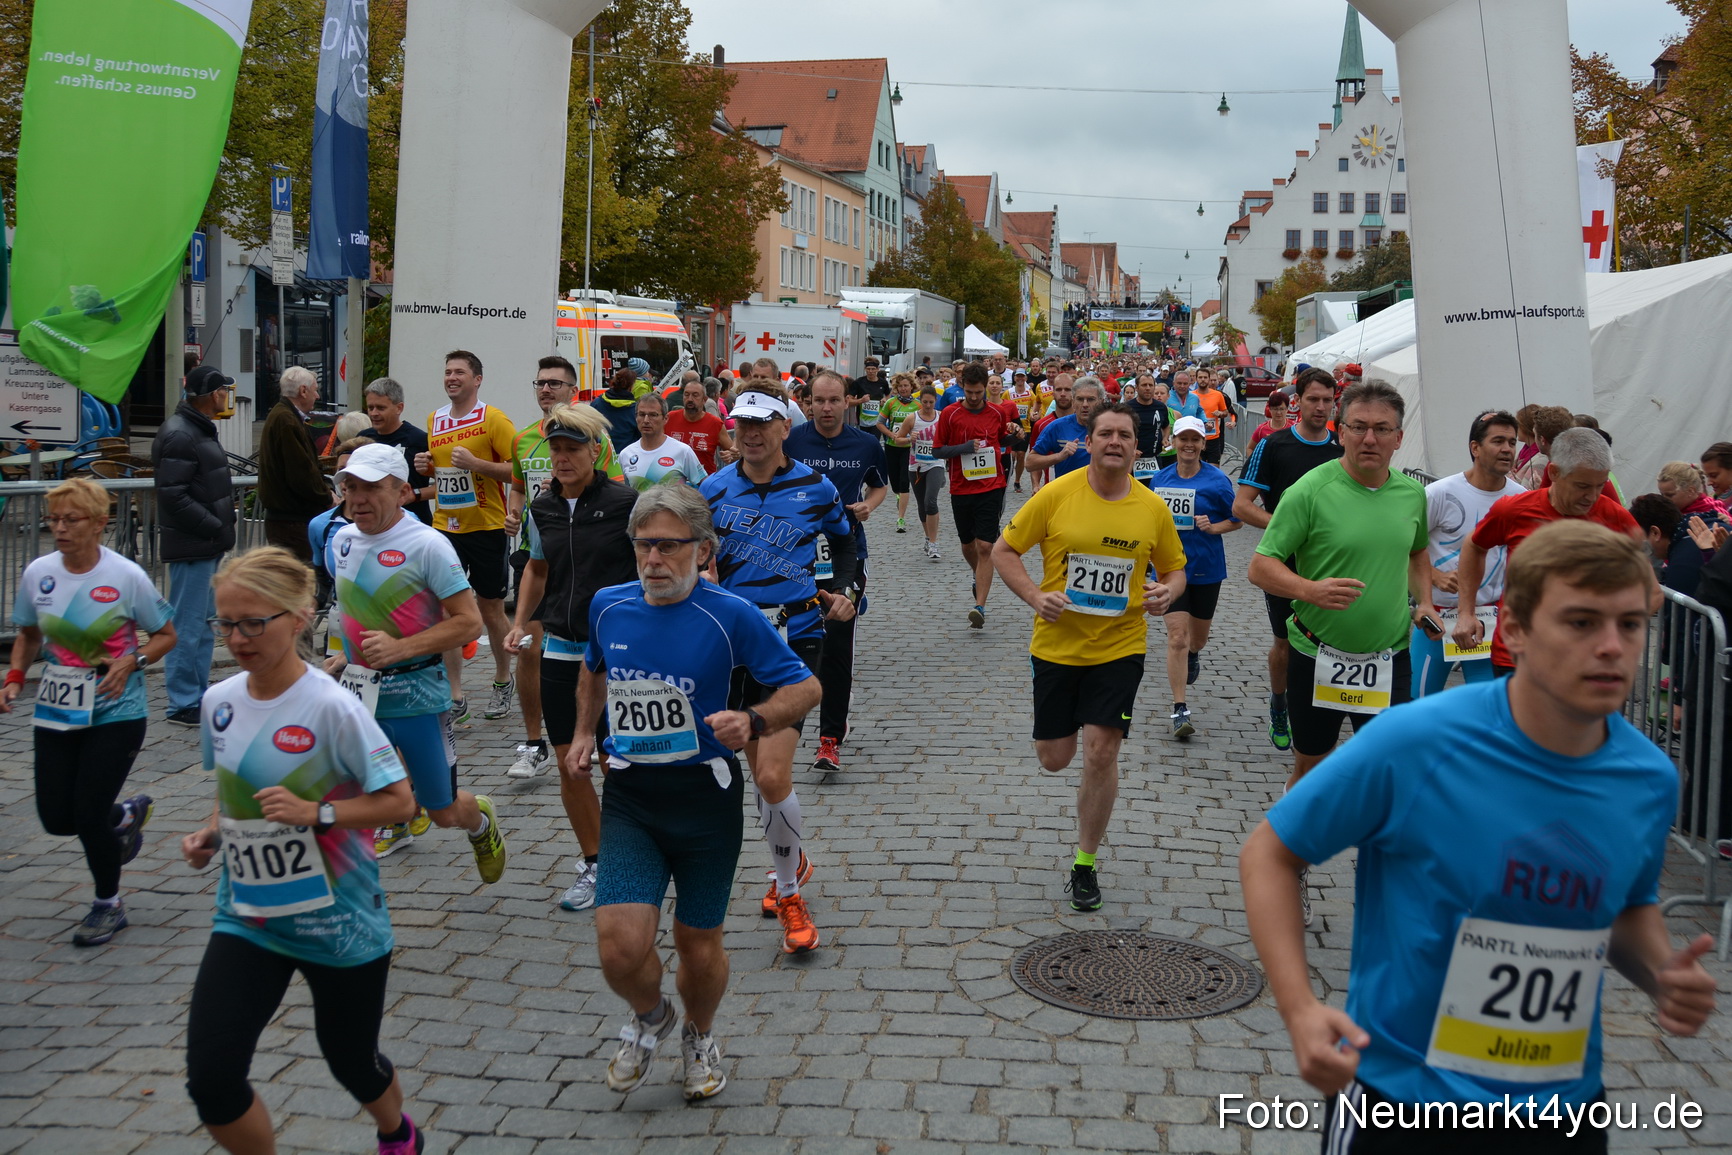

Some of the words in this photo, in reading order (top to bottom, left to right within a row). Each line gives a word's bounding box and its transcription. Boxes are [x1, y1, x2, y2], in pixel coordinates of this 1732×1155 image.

[194, 239, 203, 276] P
[226, 299, 233, 315] 3
[394, 301, 527, 319] www.bmw-laufsport.de
[1443, 304, 1585, 324] www.bmw-laufsport.de
[1112, 323, 1138, 331] START
[778, 331, 814, 341] Bayerisches
[778, 339, 796, 347] Rotes
[777, 346, 795, 354] Kreuz
[4, 379, 45, 390] Kreuzung
[46, 380, 66, 389] über
[21, 391, 50, 401] Untere
[8, 402, 63, 415] Kaserngasse
[430, 436, 454, 449] MAX
[457, 426, 487, 442] BÖGL
[803, 458, 827, 468] EURO
[835, 460, 861, 469] POLES
[971, 455, 986, 468] 15
[1135, 462, 1157, 471] 2209
[437, 476, 470, 493] 2730
[719, 503, 805, 553] TEAM
[1070, 555, 1092, 566] PARTL
[1093, 560, 1125, 570] Neumarkt
[1072, 566, 1127, 595] 2180
[1087, 596, 1106, 608] Uwe
[1319, 649, 1344, 662] PARTL
[1345, 654, 1380, 664] Neumarkt
[1330, 662, 1378, 688] 220
[39, 678, 85, 707] 2021
[630, 686, 673, 697] Neumarkt
[1339, 690, 1364, 704] Gerd
[614, 698, 686, 732] 2608
[629, 739, 672, 753] Johann
[241, 827, 292, 840] Neumarkt
[228, 839, 312, 880] 3102
[1502, 857, 1602, 913] RUN
[1460, 931, 1520, 957] PARTL
[1523, 943, 1594, 961] Neumarkt
[1480, 963, 1583, 1024] 204
[1487, 1035, 1553, 1061] Julian
